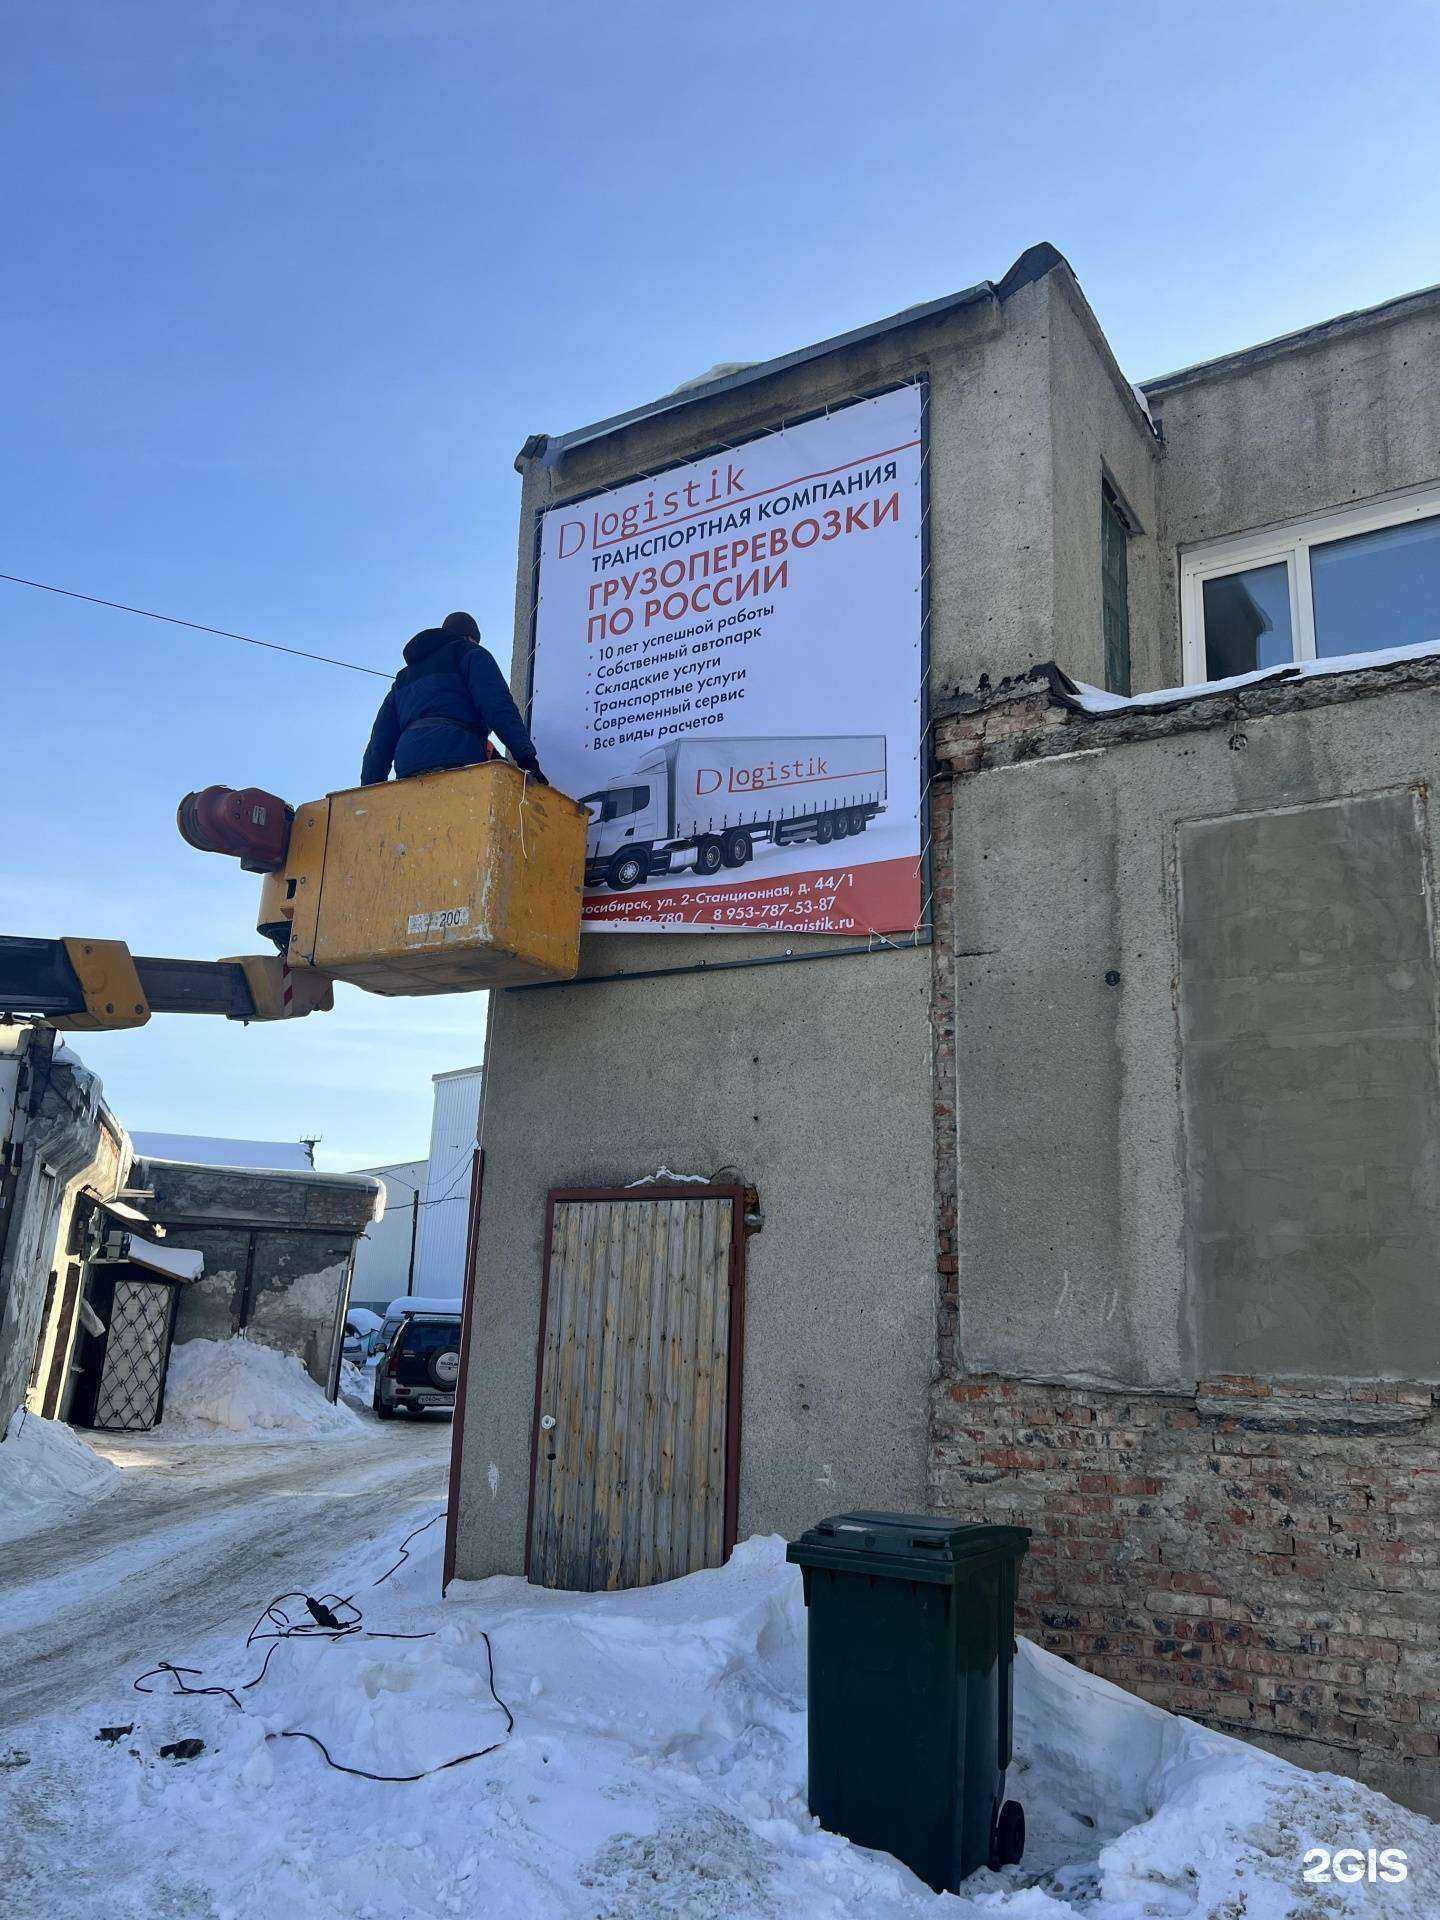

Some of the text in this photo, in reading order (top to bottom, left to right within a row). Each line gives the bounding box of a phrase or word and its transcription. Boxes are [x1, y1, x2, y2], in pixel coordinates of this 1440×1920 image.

[592, 461, 897, 572] ТРАНСПОРТНАЯ КОМПАНИЯ
[588, 492, 899, 611] ГРУЗОПЕРЕВОЗКИ
[587, 560, 788, 644] ПО РОССИИ
[597, 626, 762, 678] Собственный автопарк
[599, 605, 774, 661] 10 лет успешной работы
[593, 669, 746, 716] Транспортные услуги
[595, 656, 721, 696] Складские услуги
[593, 688, 745, 731] Современный сервис
[593, 712, 725, 750] Все виды расчетов
[582, 900, 652, 914] осибирск,
[656, 898, 676, 911] ул.
[681, 884, 794, 906] 2-Станционная,
[815, 873, 854, 891] 44/1
[713, 908, 722, 920] 8
[726, 896, 836, 920] 953-787-53-87
